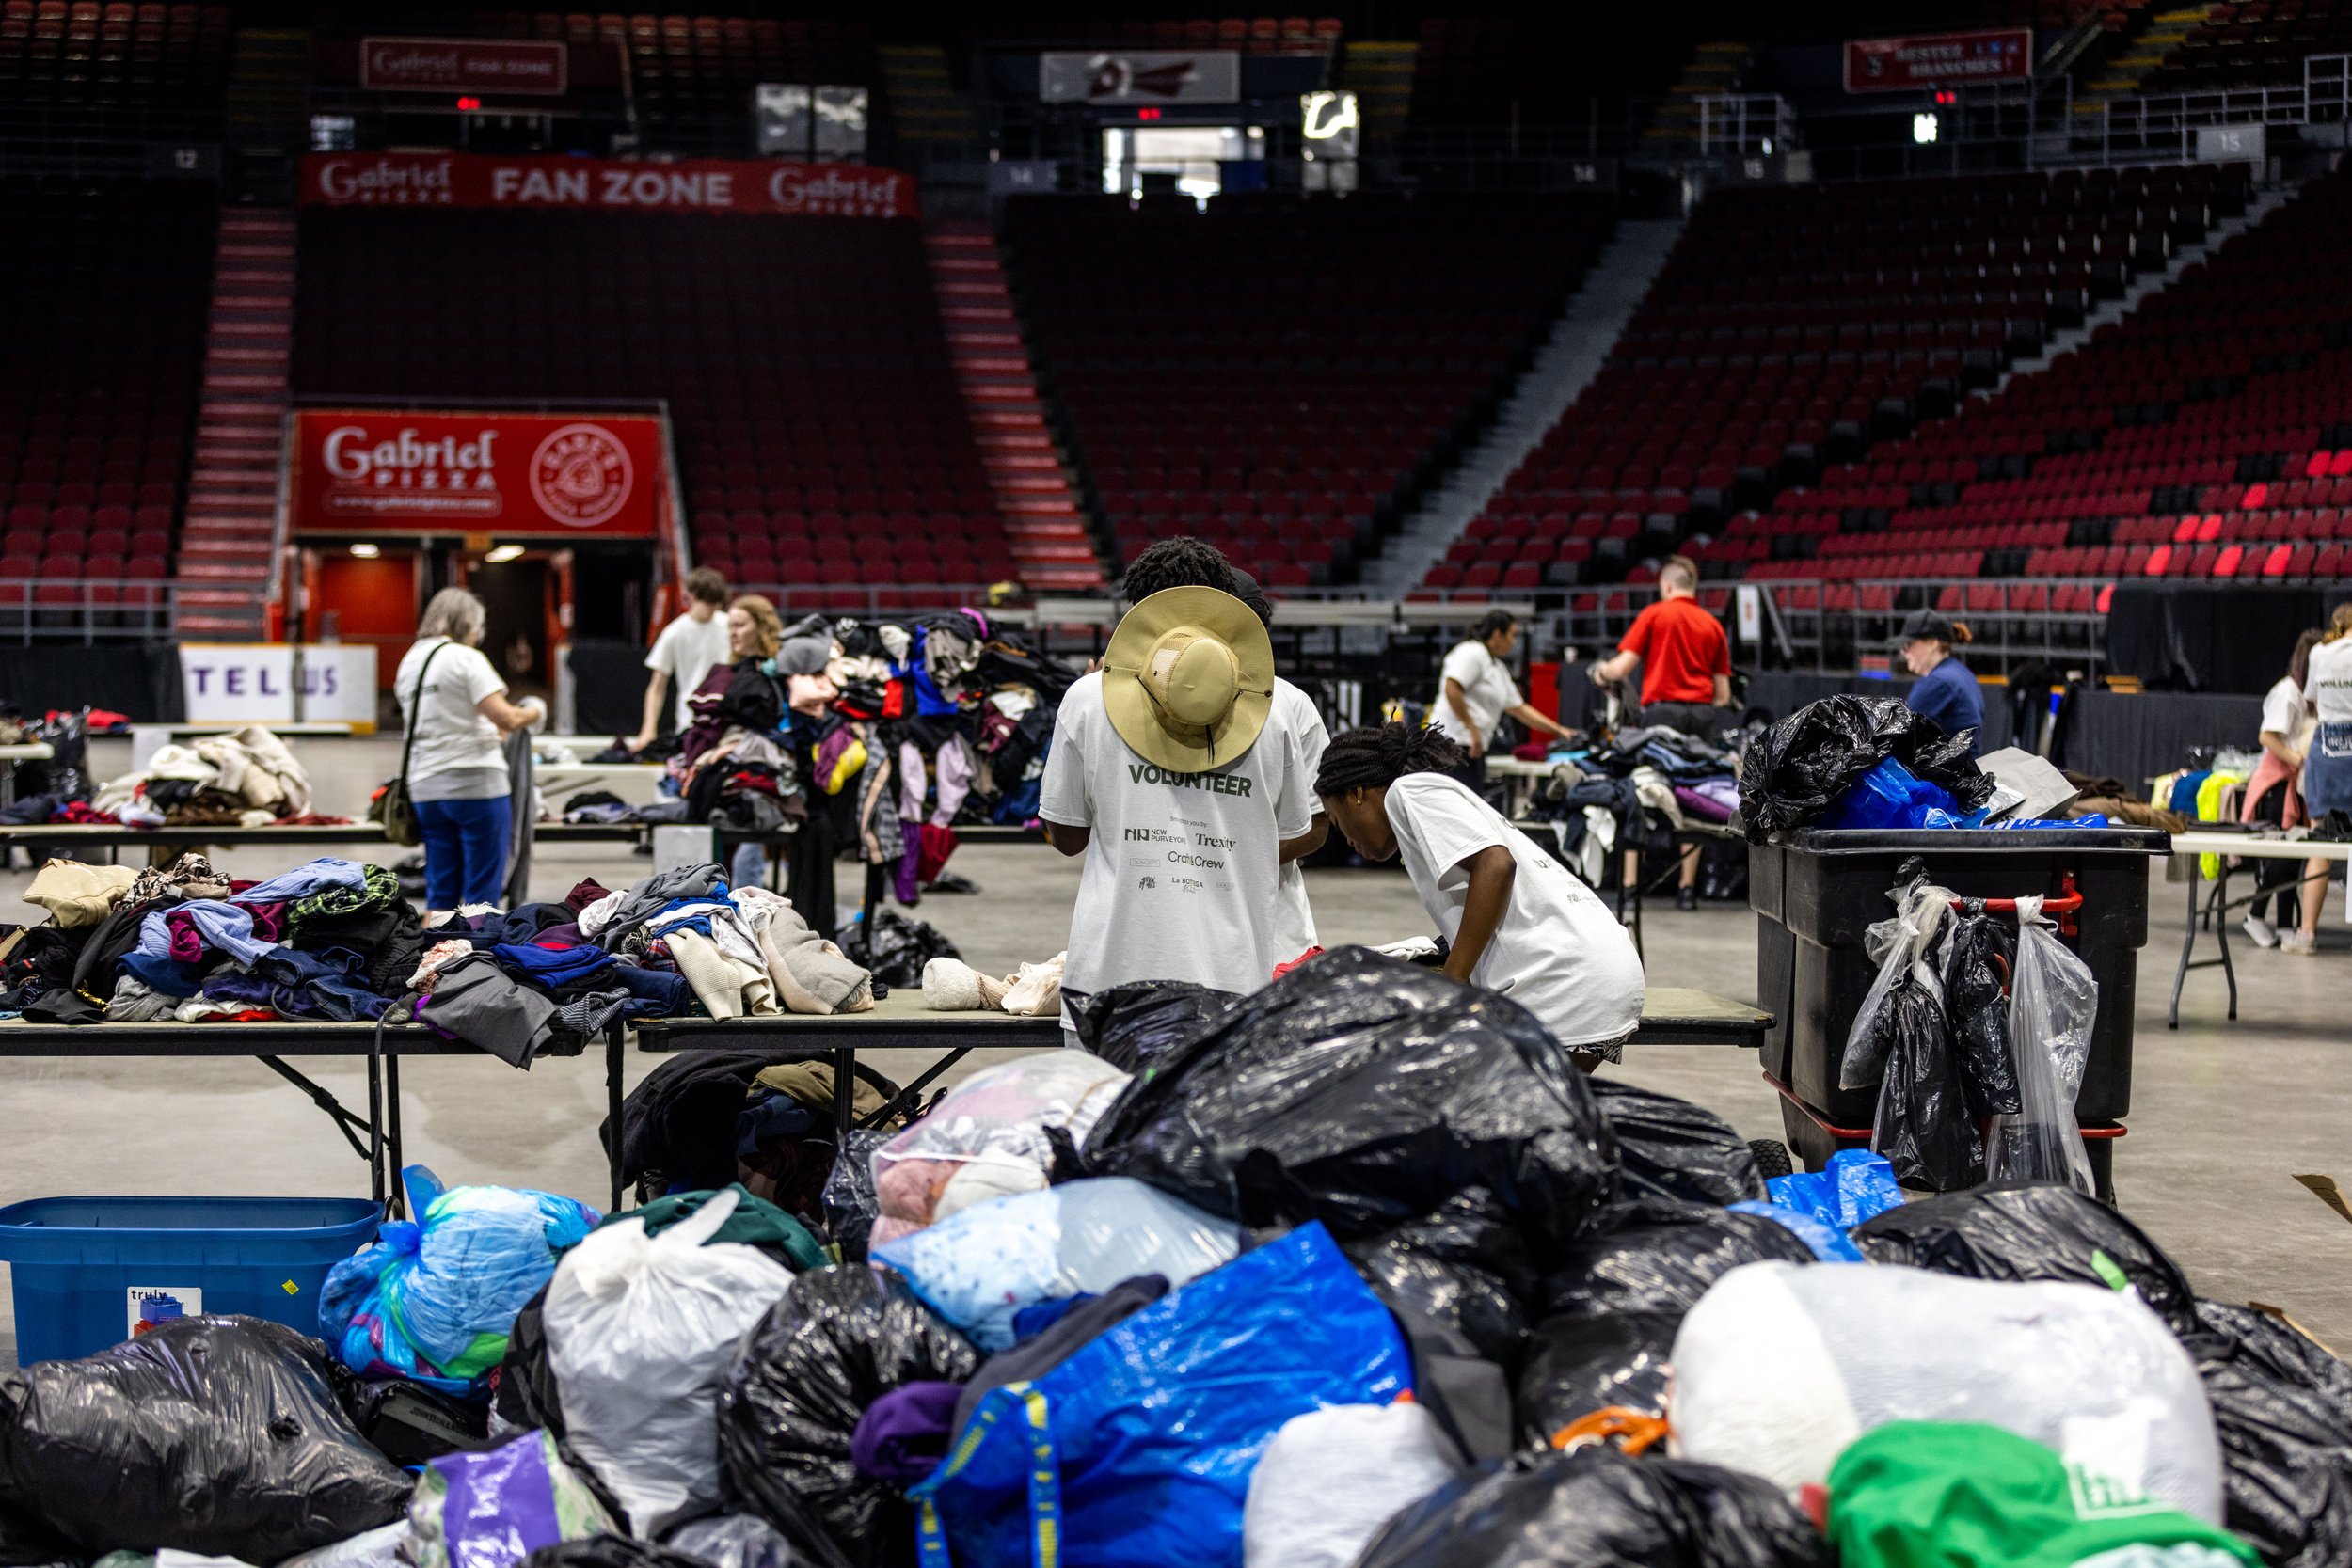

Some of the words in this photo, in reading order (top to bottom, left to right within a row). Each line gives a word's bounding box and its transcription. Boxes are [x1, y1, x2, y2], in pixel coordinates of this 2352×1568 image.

[493, 168, 589, 203] FAN
[600, 170, 734, 208] ZONE
[322, 425, 500, 480] Gabriel
[373, 467, 498, 490] PIZZA
[1127, 764, 1253, 798] VOLUNTEER
[1195, 832, 1236, 852] Trexity
[131, 1289, 167, 1305] truly
